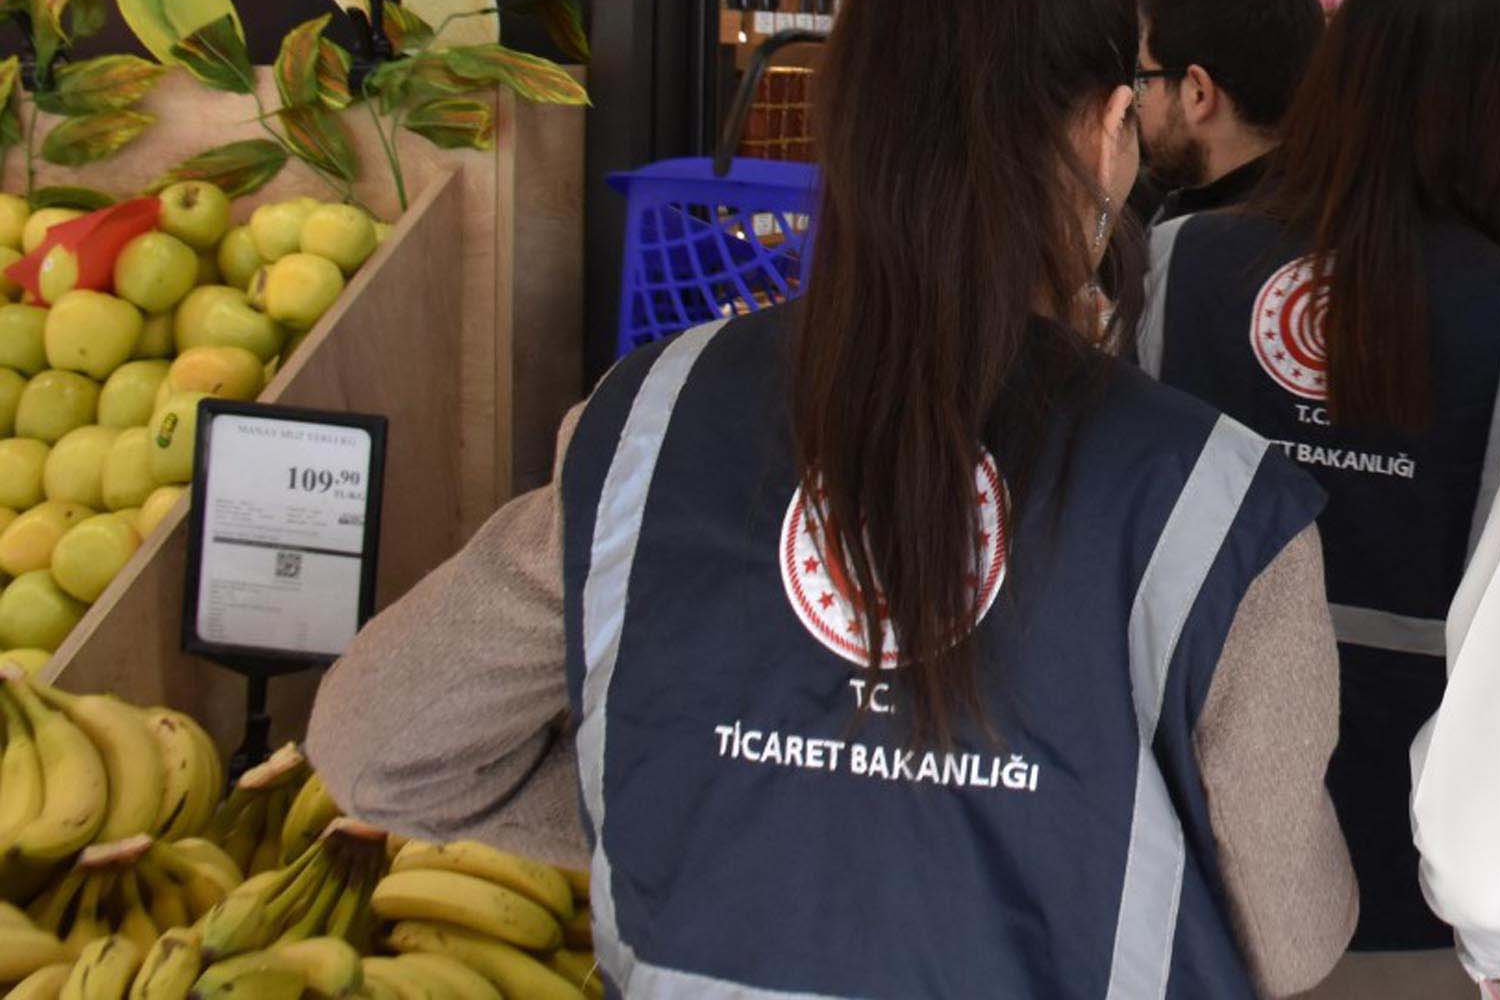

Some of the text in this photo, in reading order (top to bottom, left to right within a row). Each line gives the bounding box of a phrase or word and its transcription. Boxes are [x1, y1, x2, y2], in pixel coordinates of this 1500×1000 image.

[1295, 404, 1331, 426] T.C.
[1296, 442, 1416, 479] BAKANLIĞI
[849, 678, 896, 715] TC.
[713, 720, 1040, 792] TİCARET BAKANLIĞI
